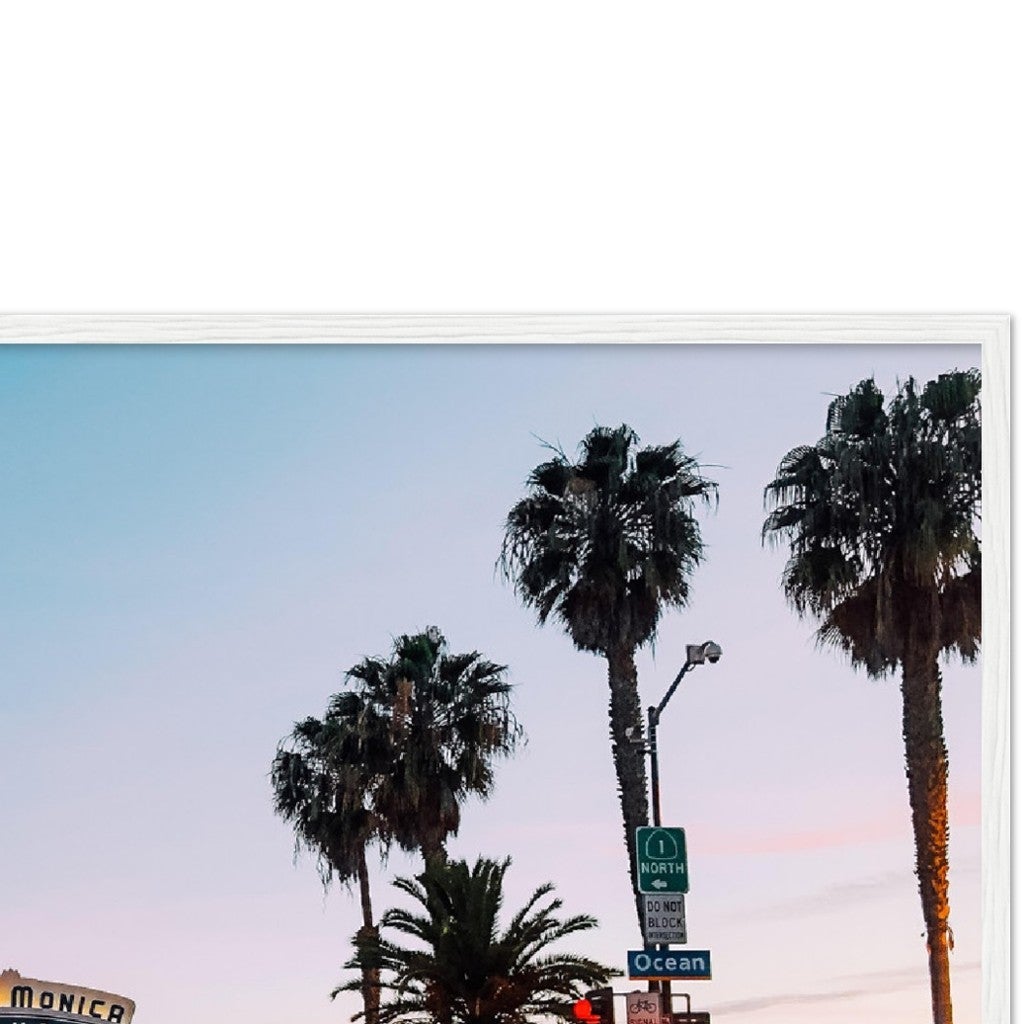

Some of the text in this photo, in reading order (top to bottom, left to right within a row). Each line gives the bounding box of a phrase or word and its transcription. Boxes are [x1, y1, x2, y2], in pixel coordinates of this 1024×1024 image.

[659, 839, 665, 854] 1
[640, 862, 685, 875] NORTH
[647, 901, 683, 913] DO NOT
[648, 917, 683, 928] BLOCK
[634, 953, 706, 972] Ocean
[11, 986, 125, 1024] MONICA
